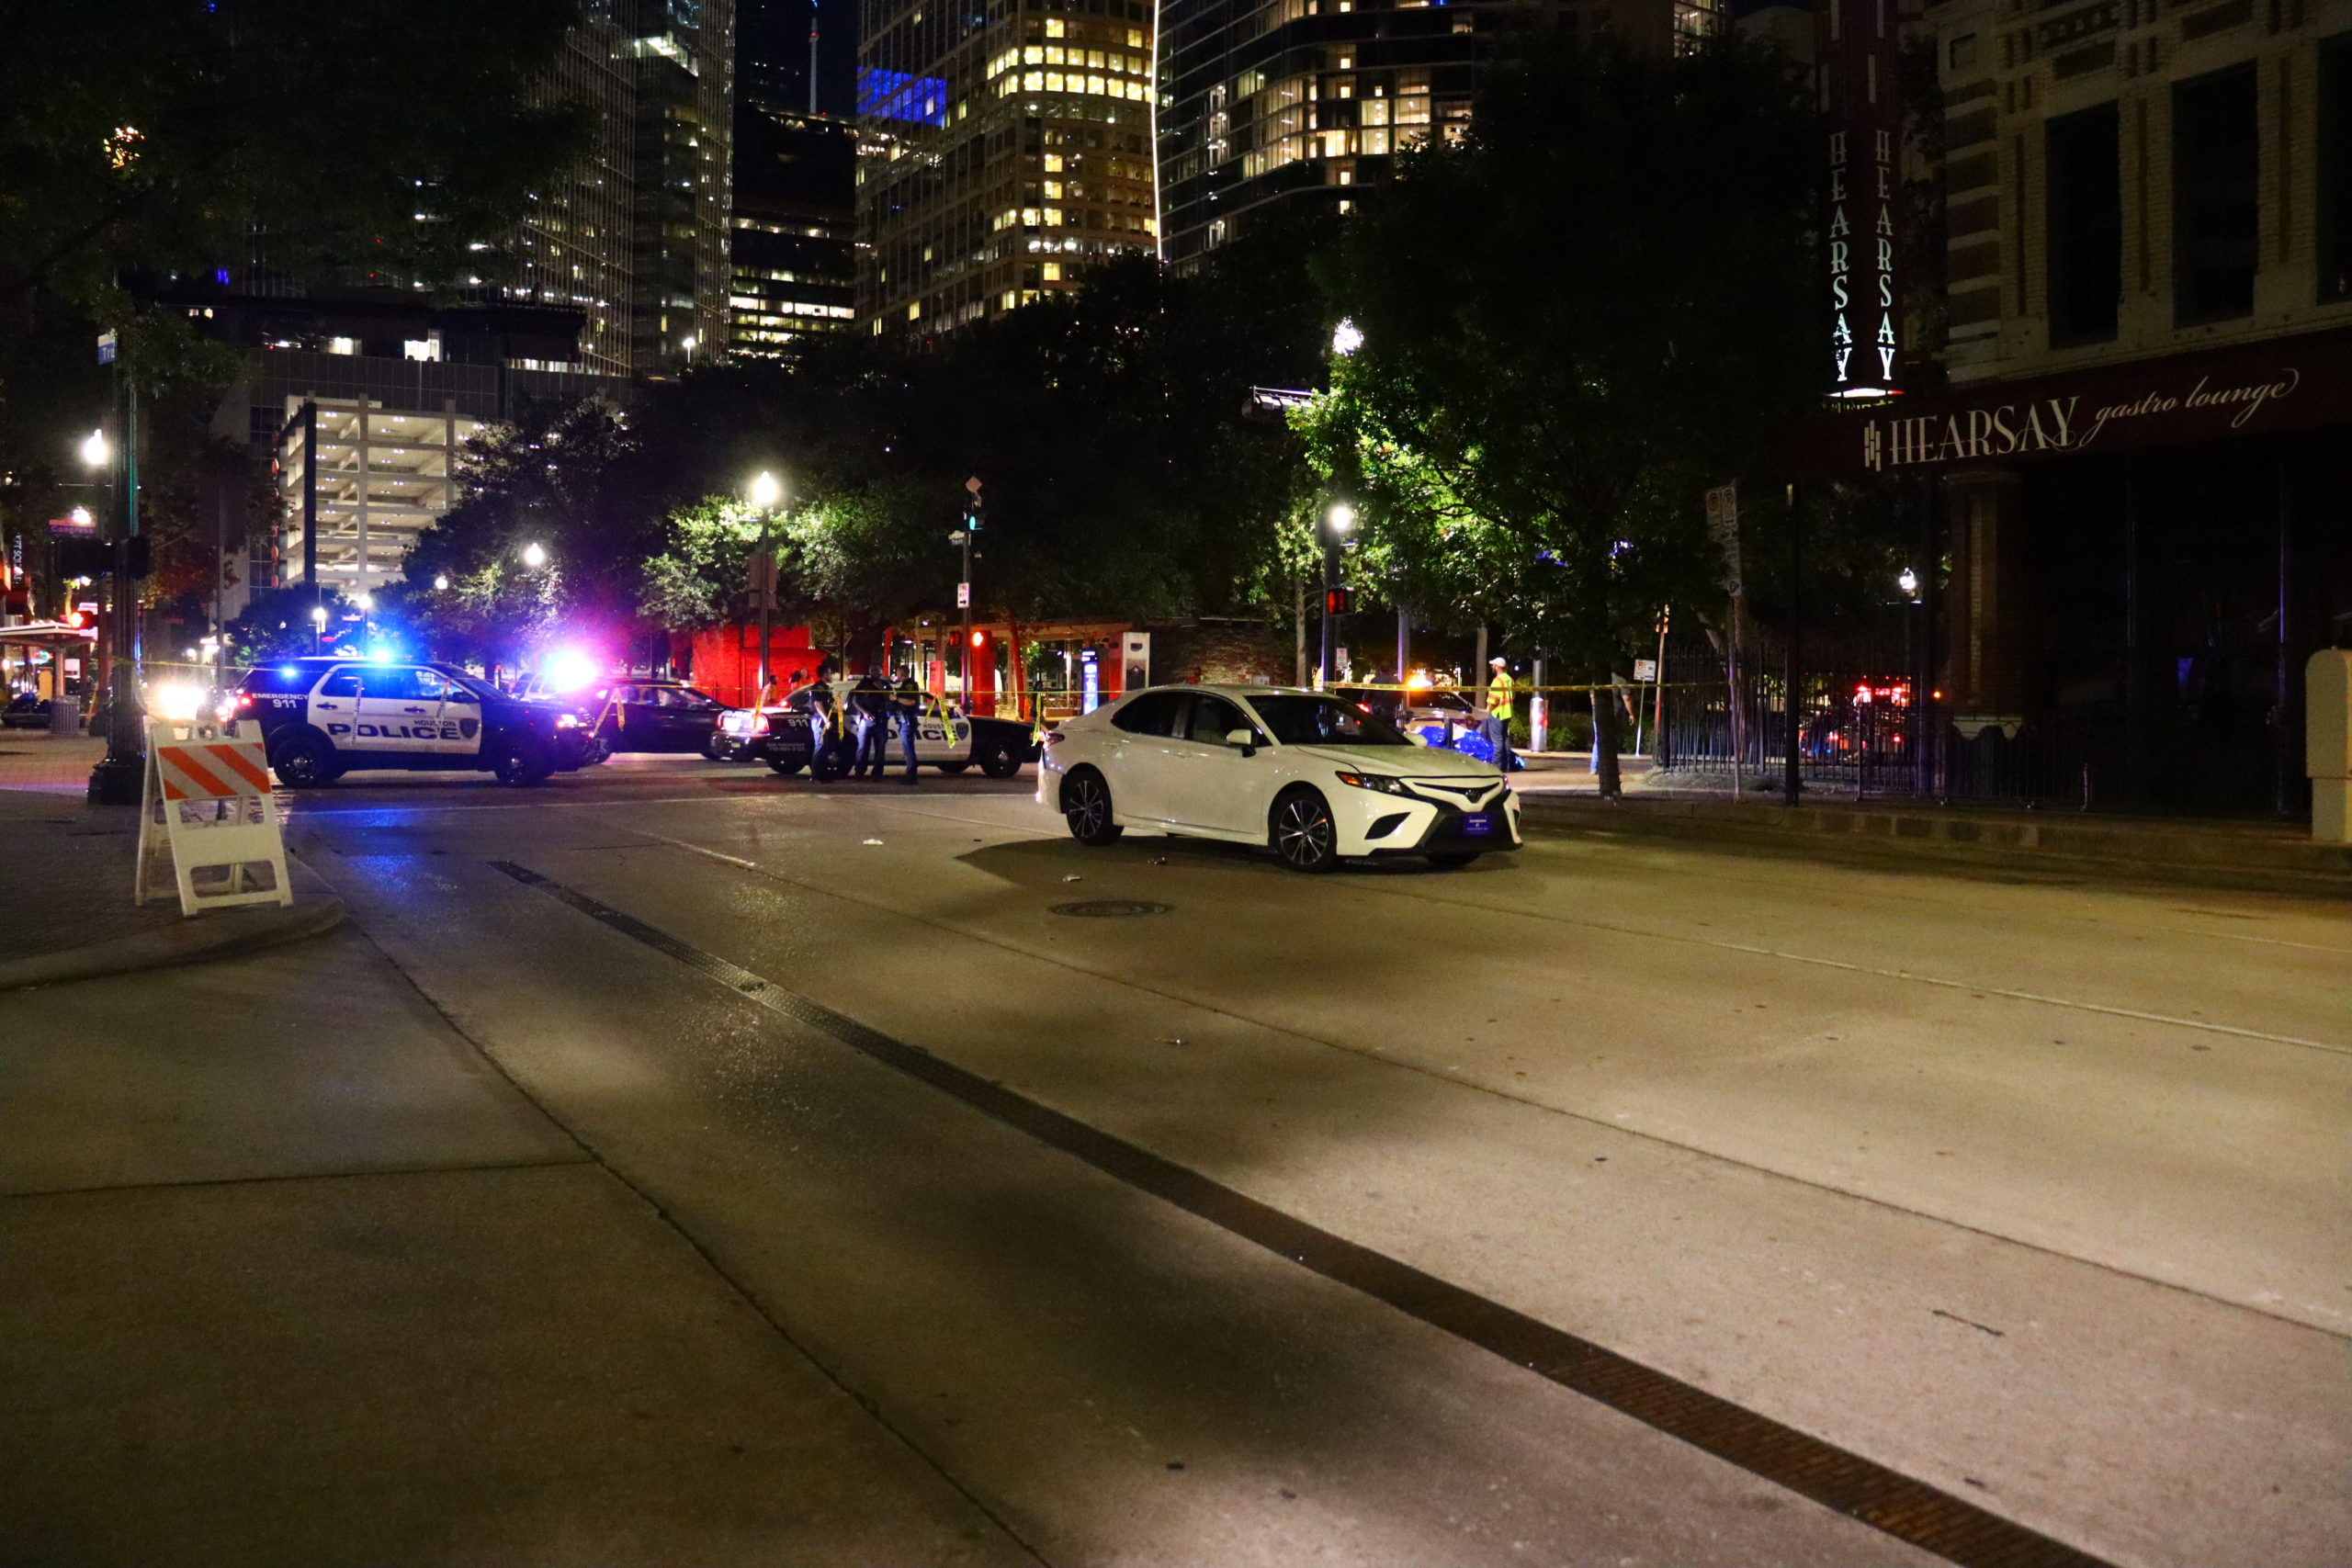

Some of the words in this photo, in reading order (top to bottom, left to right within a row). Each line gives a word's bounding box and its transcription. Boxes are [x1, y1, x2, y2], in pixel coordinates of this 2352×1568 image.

[1829, 130, 1852, 382] HEARSAY
[1875, 130, 1895, 381] HEARSAY
[1889, 395, 2081, 465] HEARSAY
[2079, 390, 2179, 447] gastro
[2185, 367, 2300, 428] lounge
[273, 699, 297, 708] 911
[327, 723, 460, 739] POLICE
